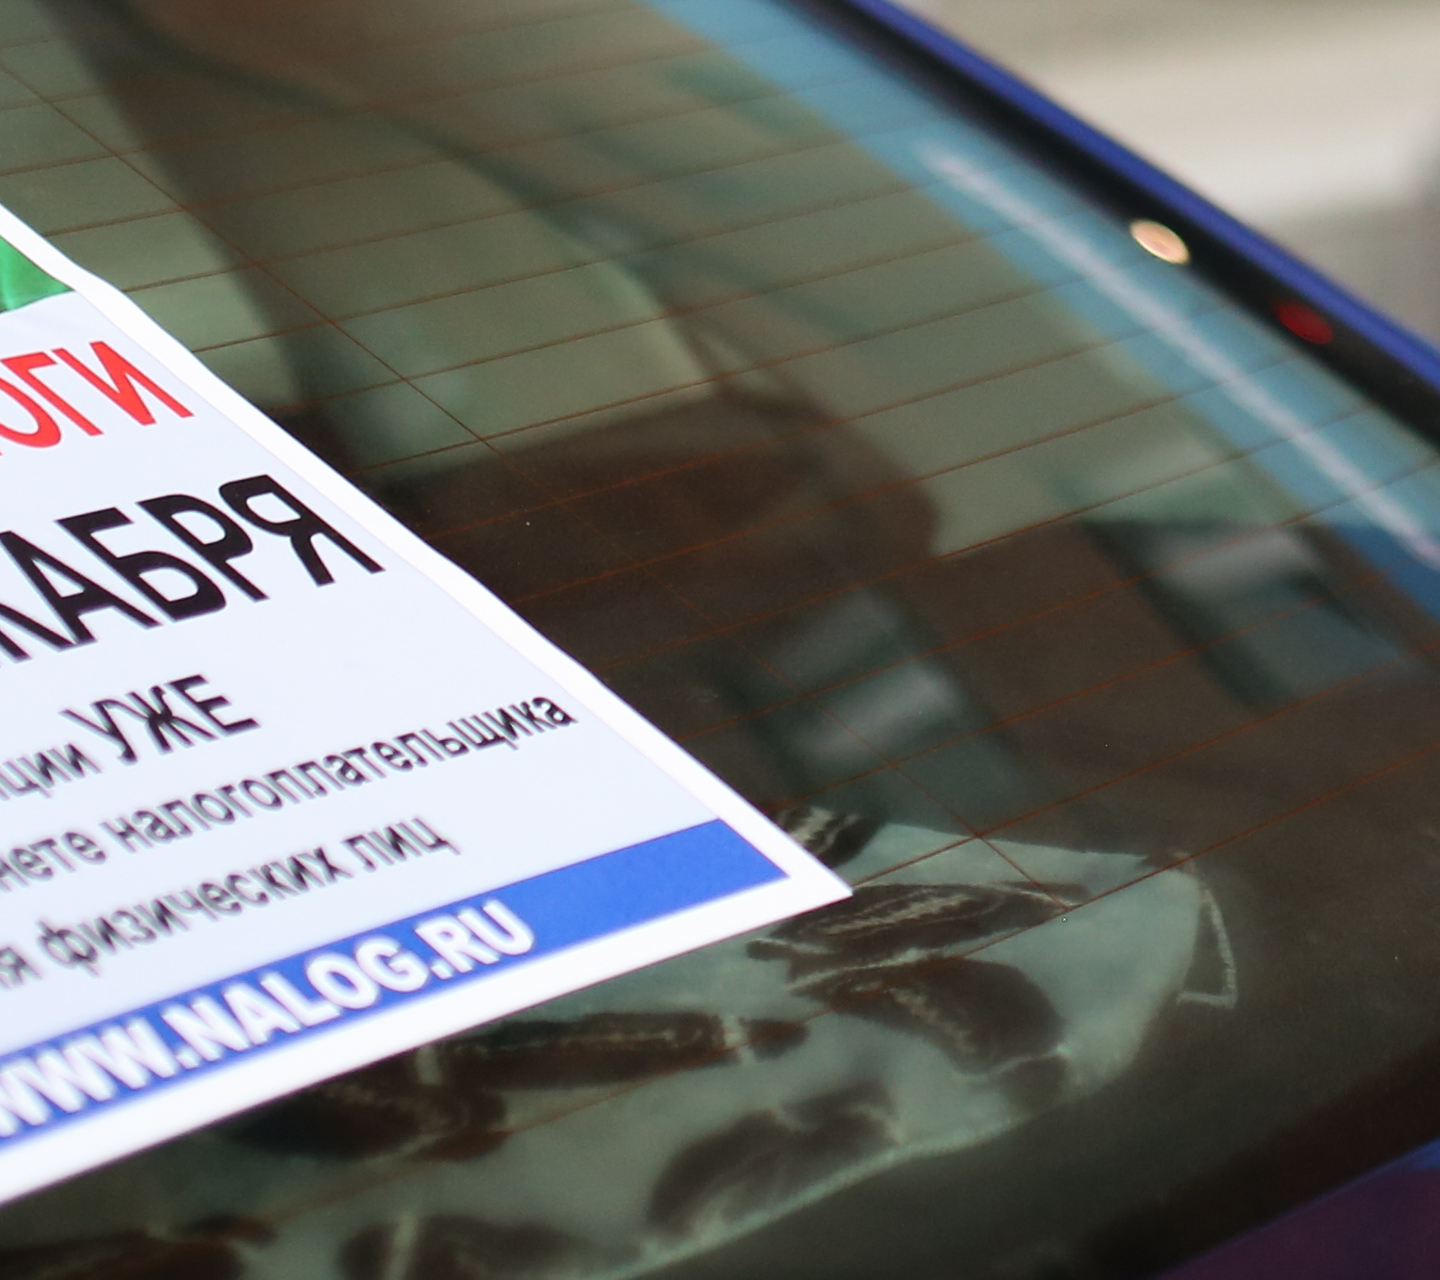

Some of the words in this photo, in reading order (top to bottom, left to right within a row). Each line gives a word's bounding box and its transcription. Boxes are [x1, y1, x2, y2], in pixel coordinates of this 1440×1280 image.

[60, 673, 262, 765] УЖЕ
[115, 690, 577, 857] налогоплательщика
[37, 842, 344, 975] физических
[336, 815, 459, 883] лиц
